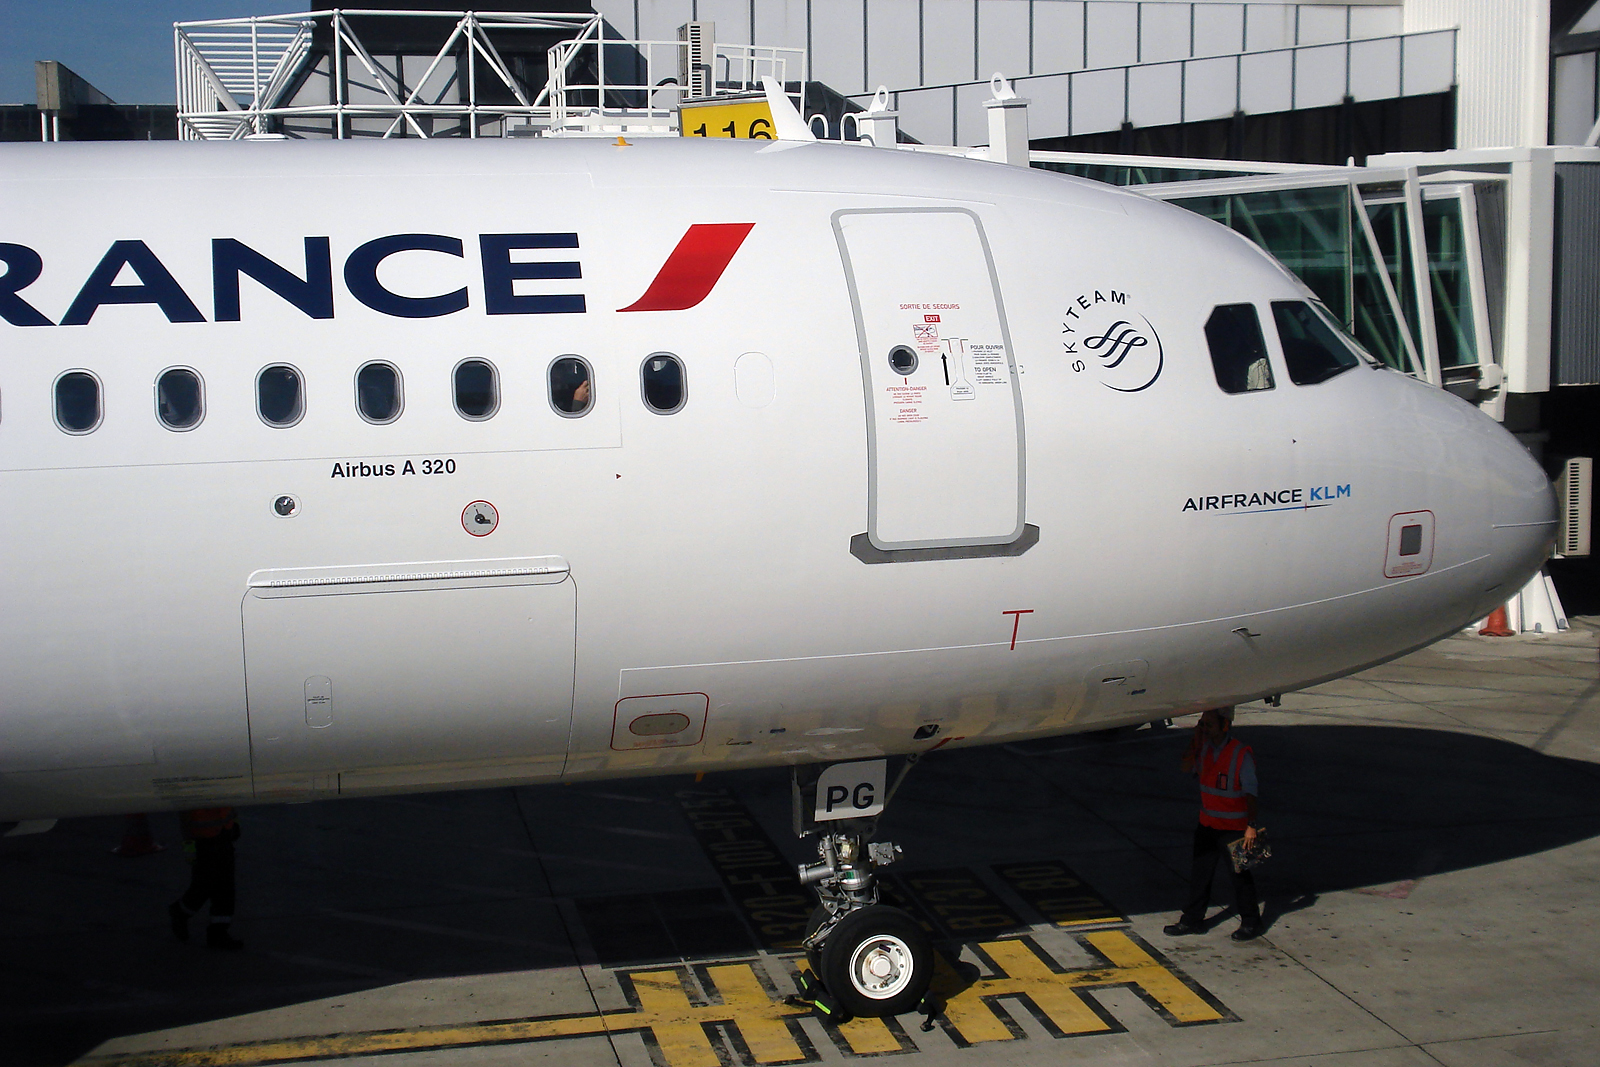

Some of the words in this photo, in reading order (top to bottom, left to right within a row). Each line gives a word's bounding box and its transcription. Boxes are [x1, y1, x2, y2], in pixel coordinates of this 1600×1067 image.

[1062, 289, 1126, 373] SKYTEAM
[331, 461, 396, 478] Airbus
[401, 459, 416, 475] A
[421, 458, 456, 475] 320
[1182, 488, 1303, 512] AIRFRANCE
[1309, 483, 1351, 501] KLM
[826, 782, 875, 813] PG
